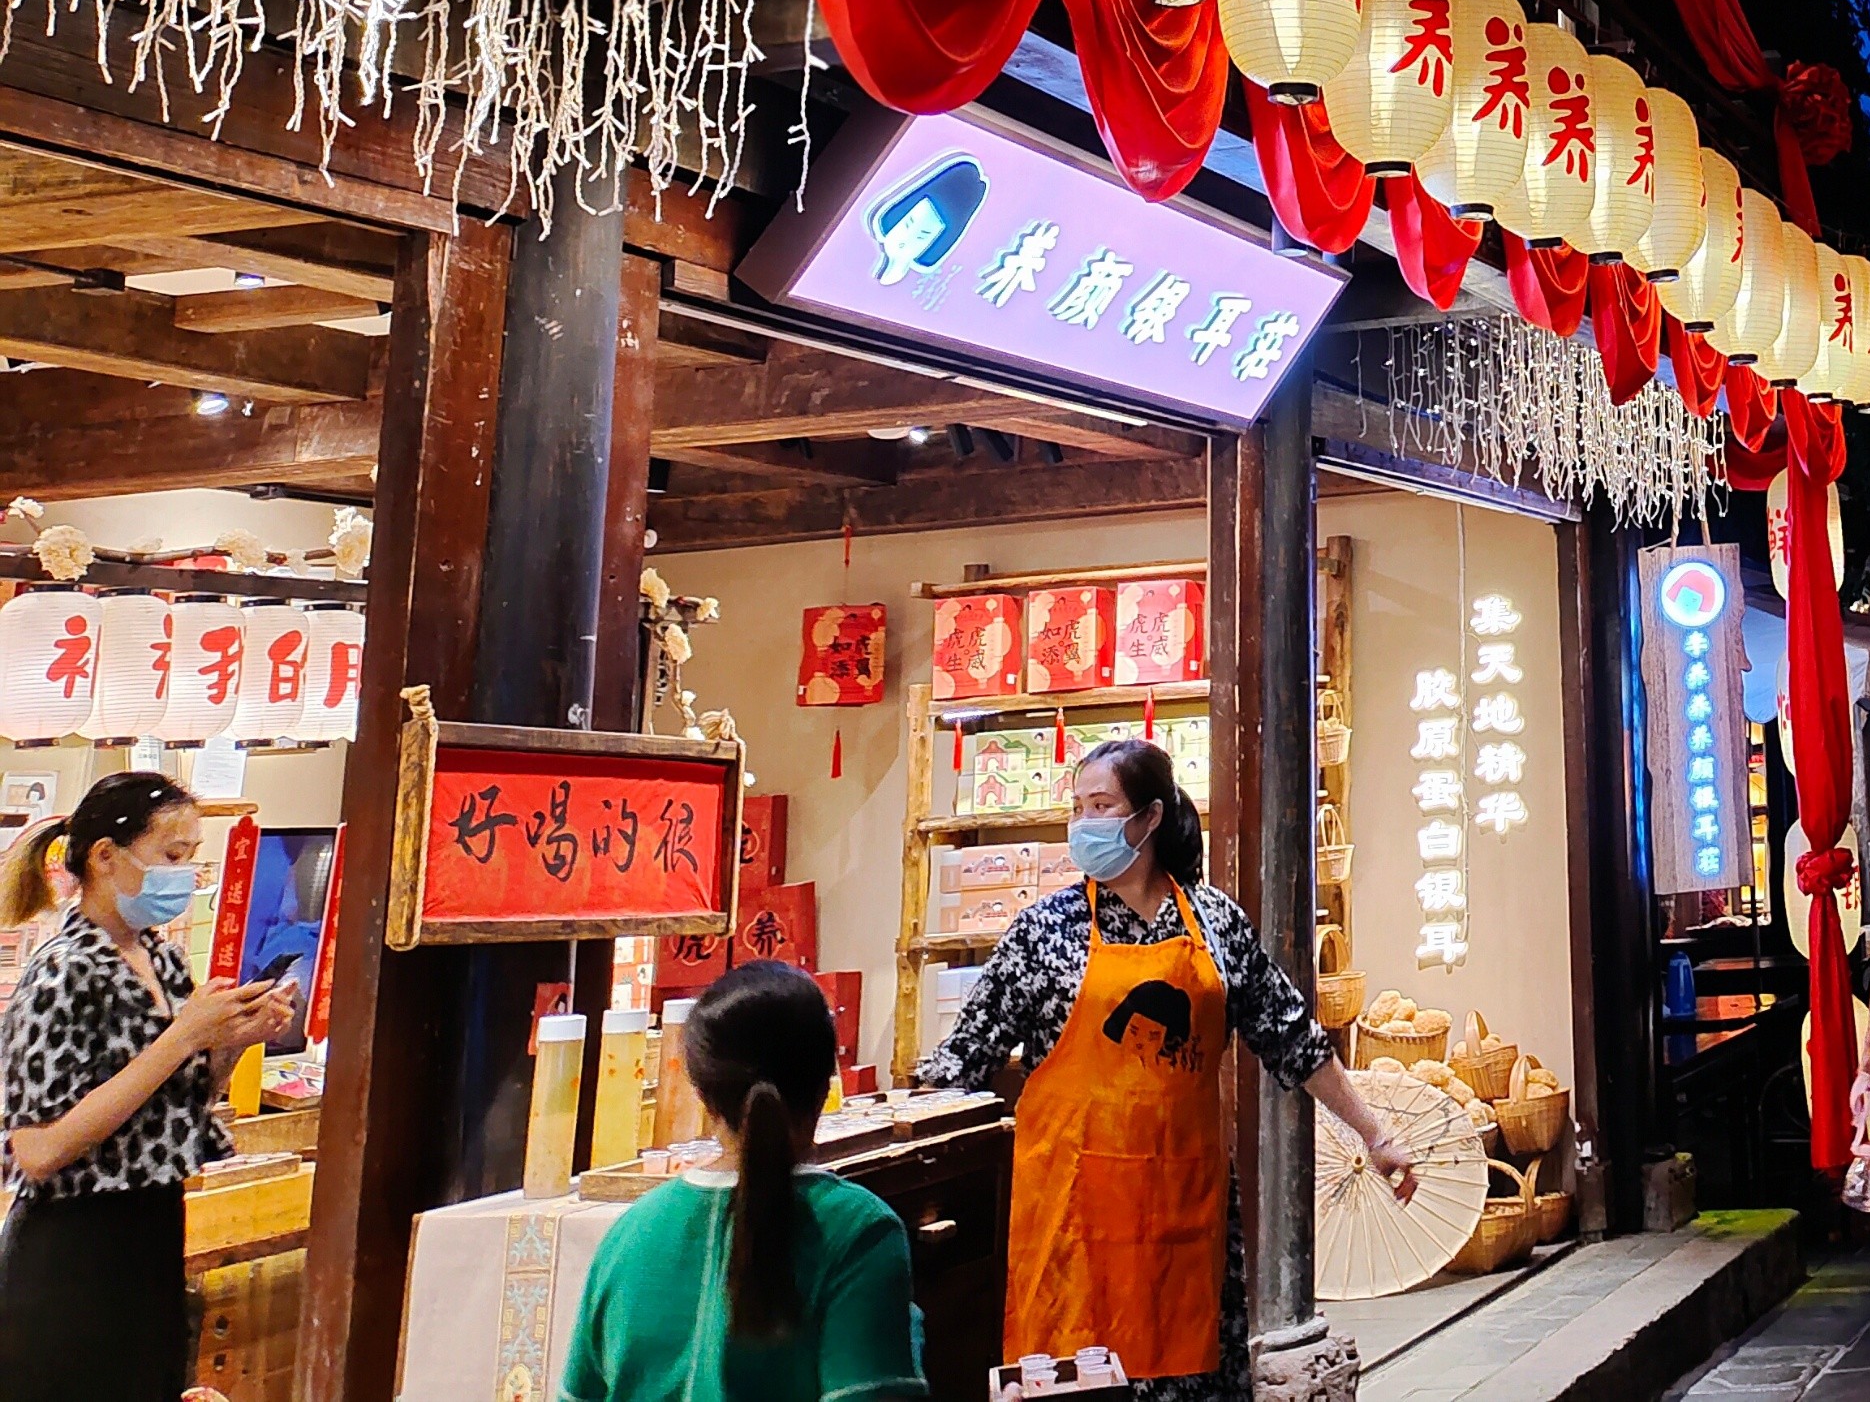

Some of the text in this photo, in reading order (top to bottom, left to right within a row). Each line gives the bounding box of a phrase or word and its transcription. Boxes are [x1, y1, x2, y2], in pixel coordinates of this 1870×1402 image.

[1472, 16, 1530, 139] 养
[1542, 66, 1595, 183] 养
[1470, 594, 1527, 834] 集天地精华
[449, 780, 698, 883] 好喝的很
